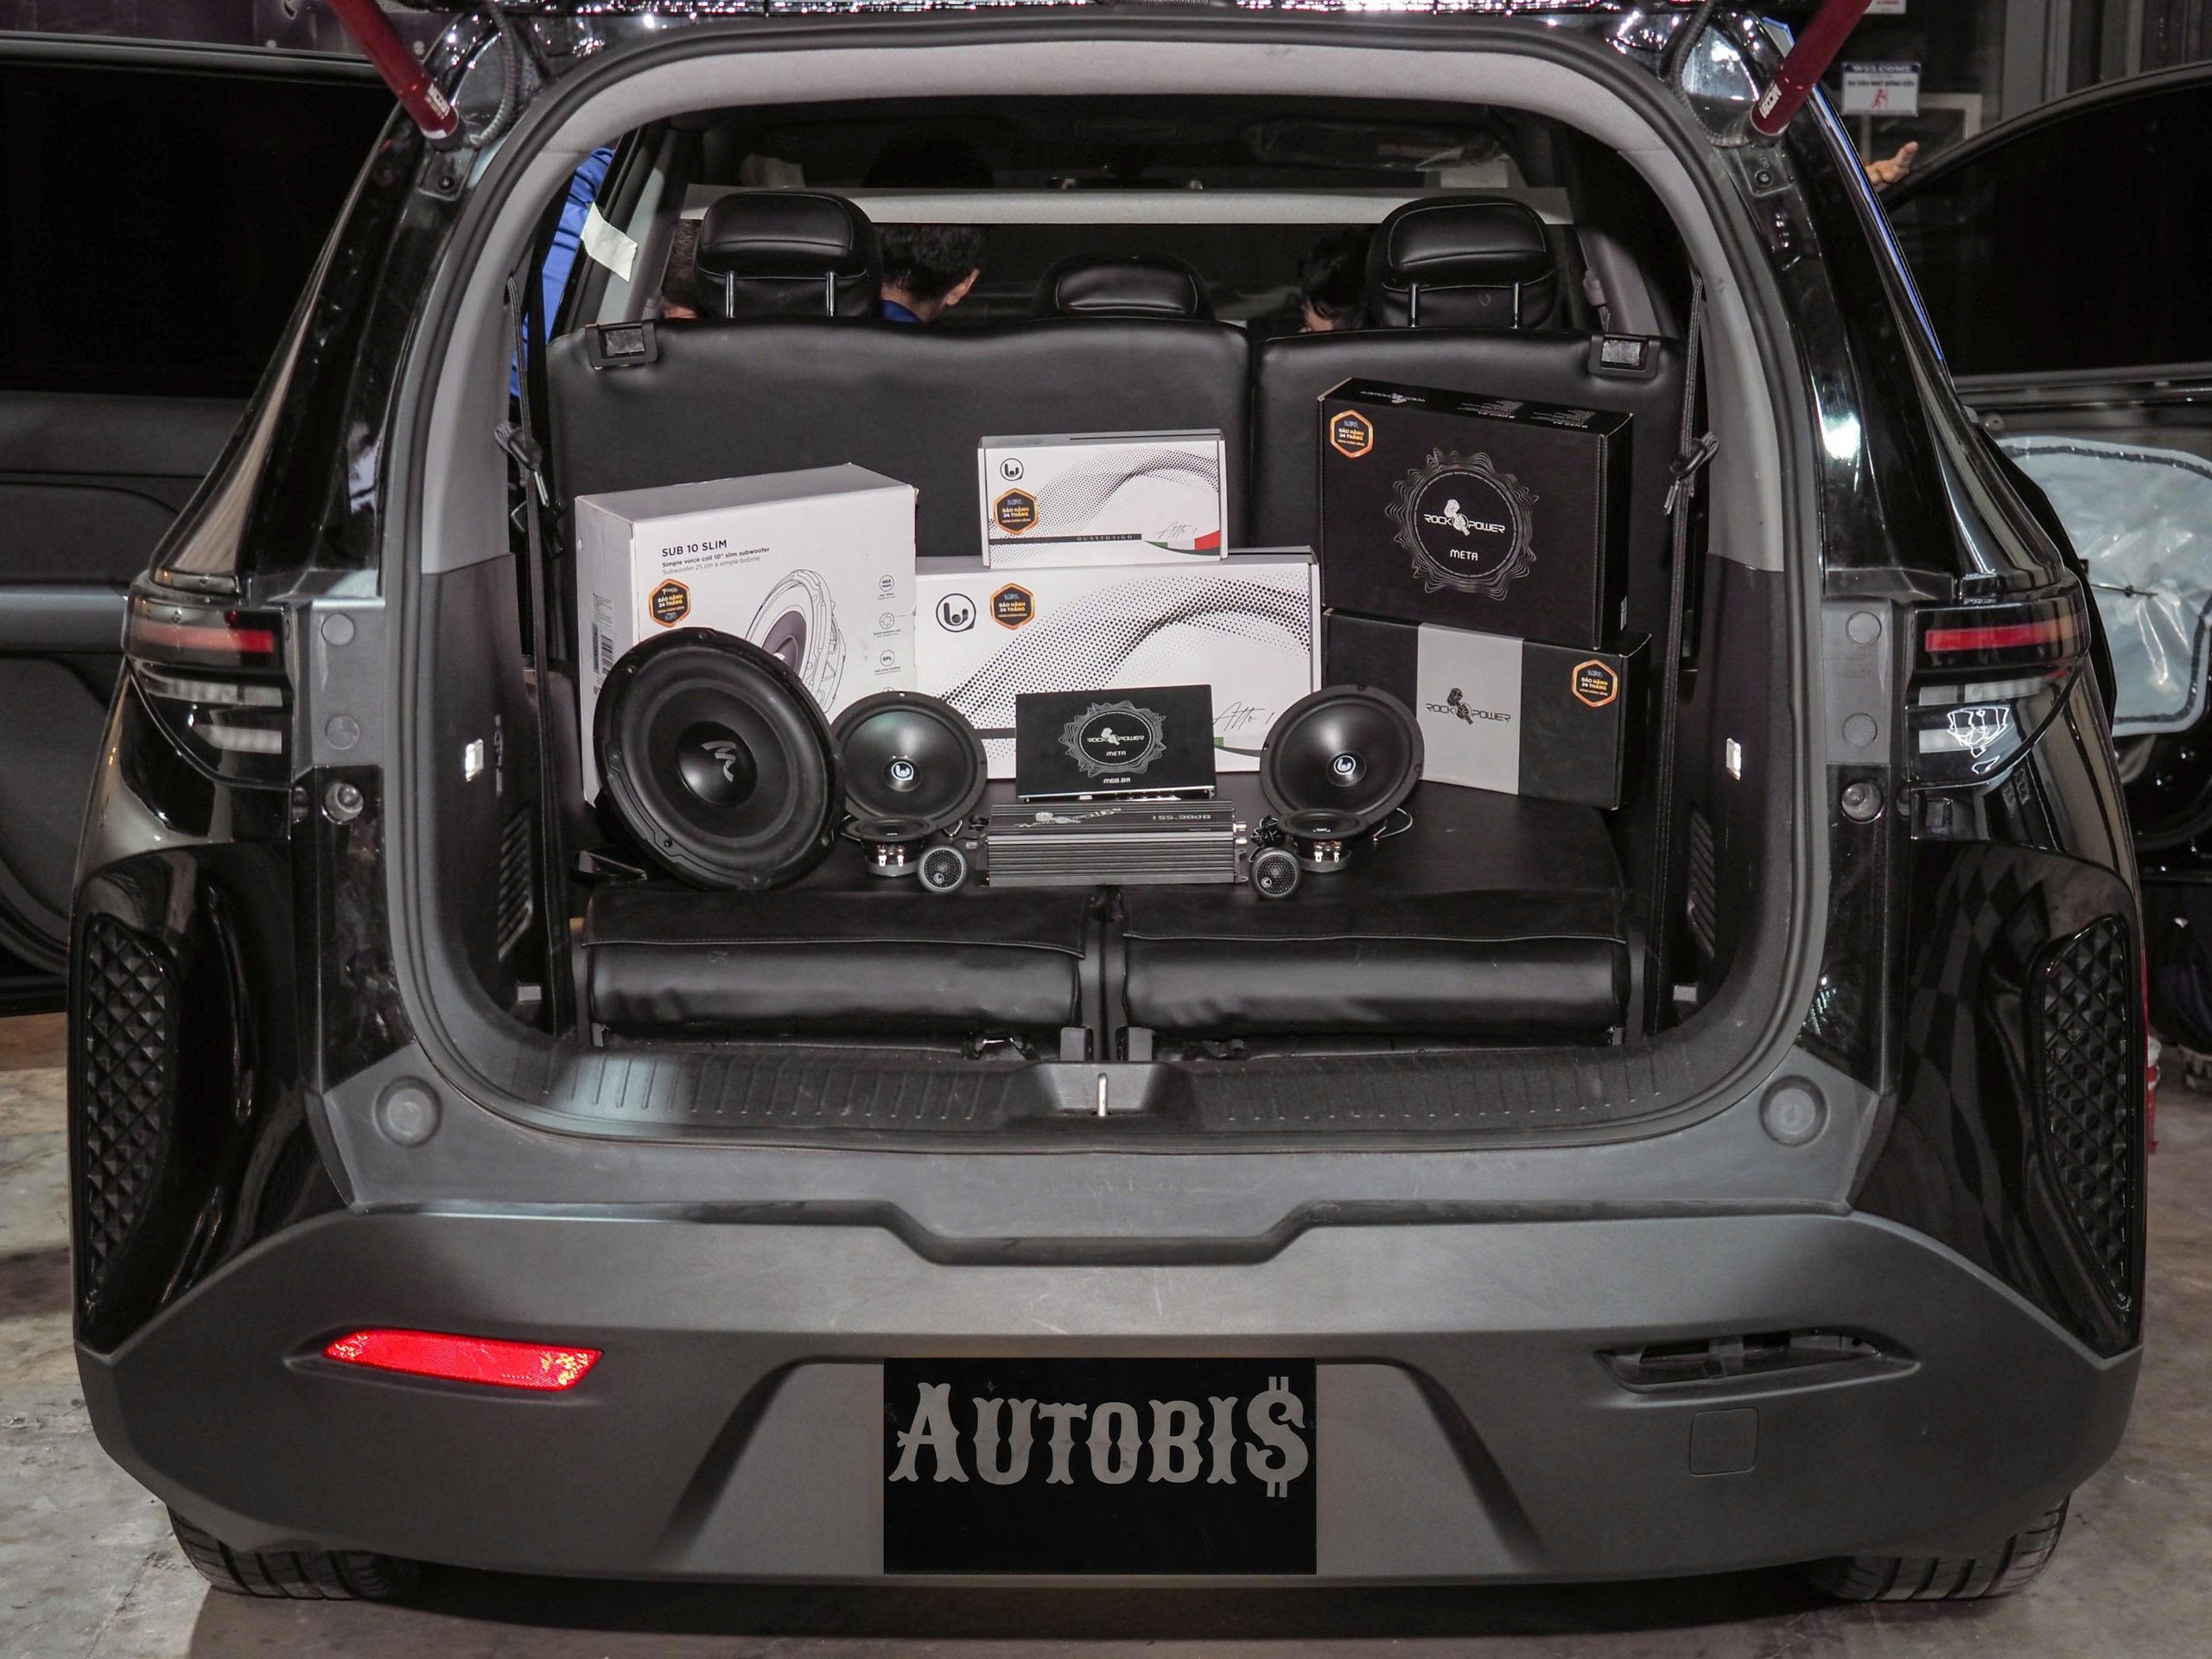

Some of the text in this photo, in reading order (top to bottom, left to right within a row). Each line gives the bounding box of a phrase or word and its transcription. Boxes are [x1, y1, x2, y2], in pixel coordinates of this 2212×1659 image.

[1424, 513, 1505, 534] ROCK POWER
[662, 539, 727, 557] SUB 10 SLIM
[662, 559, 683, 568] Simple
[684, 556, 700, 566] voice
[739, 547, 770, 556] subwoofer
[1450, 549, 1478, 562] META
[663, 565, 694, 575] Subwoofer
[1426, 702, 1511, 723] ROCK POWER
[888, 1376, 1309, 1498] AUTOBI$
